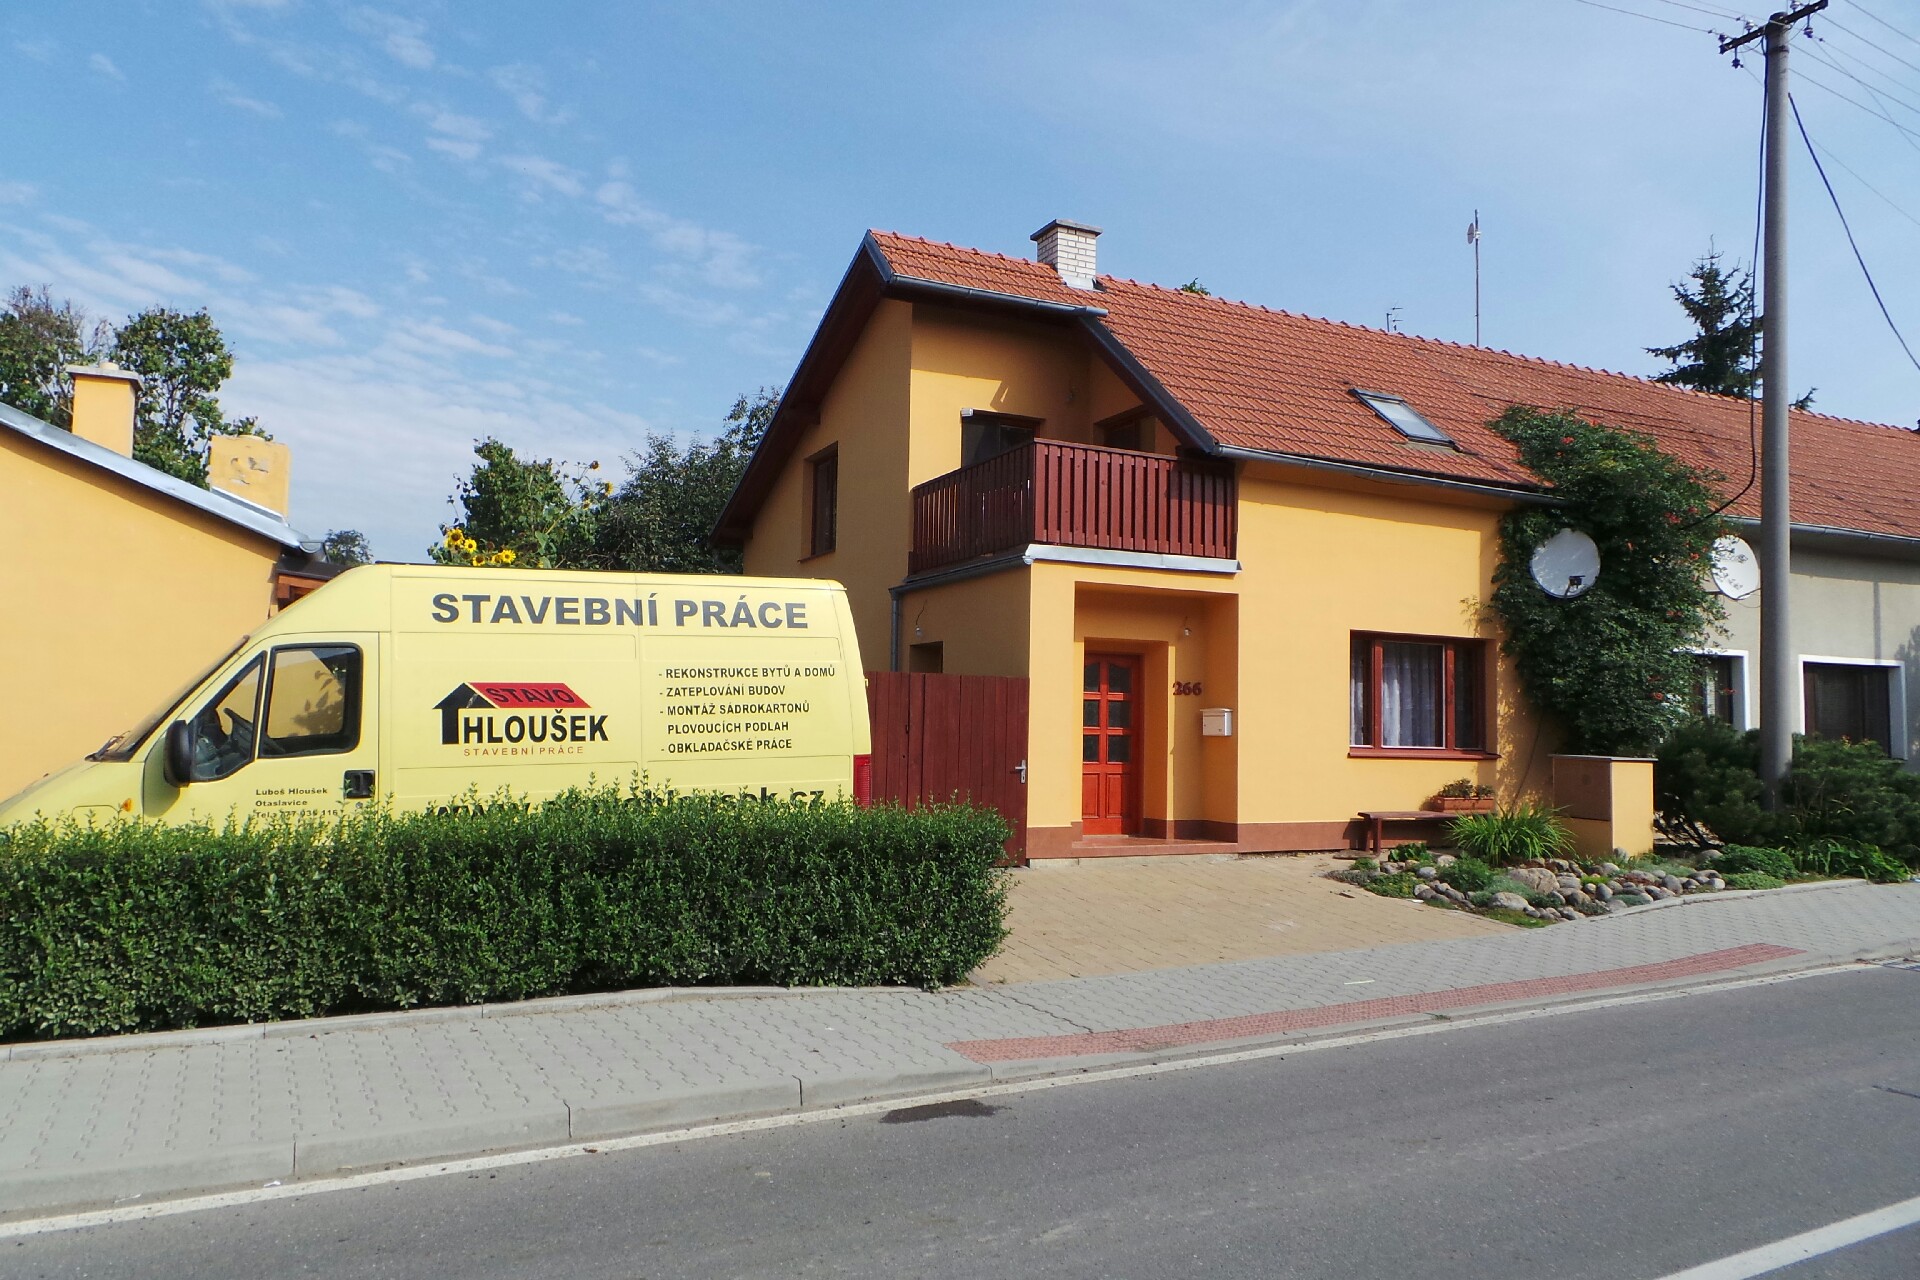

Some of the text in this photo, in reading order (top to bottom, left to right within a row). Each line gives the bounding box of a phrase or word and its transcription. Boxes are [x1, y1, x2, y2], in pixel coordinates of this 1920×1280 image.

[431, 593, 809, 629] STAVEBNÍ PRÁCE
[666, 667, 759, 679] REKONSTRUKCE
[762, 664, 791, 677] BYTŮ
[794, 667, 802, 677] A
[804, 664, 836, 677] DOMŮ
[485, 687, 575, 704] STAVO
[666, 684, 745, 697] ZATEPLOVÁNÍ
[748, 685, 786, 696] BUDOV
[1172, 681, 1202, 696] 266
[667, 702, 716, 716] MONTÁŽ
[719, 700, 810, 714] SÁDROKARTONŮ
[463, 708, 609, 744] HLOUŠEK
[667, 720, 789, 734] PLOVOUCÍCH PODLAH
[463, 745, 584, 757] STAVEBNÍ PRÁCE
[668, 738, 753, 753] OBKLADAČSKÉ
[756, 738, 793, 750] PRÁCE
[255, 787, 328, 796] Luboš Hloušek
[255, 799, 308, 807] Otaslavice
